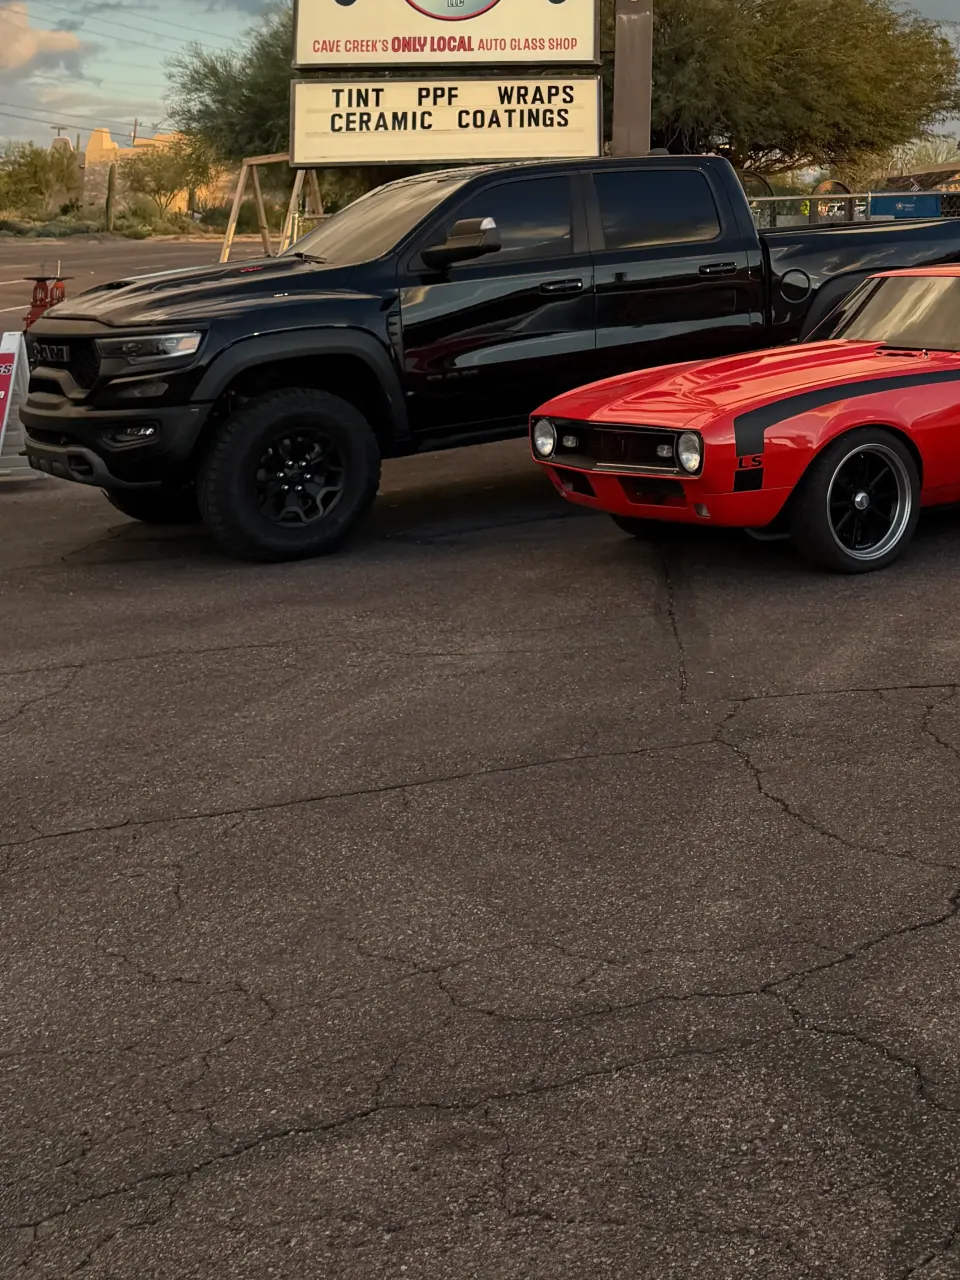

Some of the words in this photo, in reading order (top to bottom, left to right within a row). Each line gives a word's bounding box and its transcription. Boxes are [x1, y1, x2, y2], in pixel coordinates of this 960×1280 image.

[312, 40, 341, 53] CAVE
[344, 39, 389, 53] CREEK'S
[391, 37, 427, 52] ONLY
[430, 36, 474, 52] LOCAL
[478, 38, 506, 51] AUTO
[510, 38, 545, 51] GLASS
[548, 37, 578, 51] SHOP
[332, 88, 384, 108] TINT
[417, 87, 459, 106] PPF
[498, 85, 574, 105] WRAPS
[330, 111, 433, 132] CERAMIC
[457, 108, 569, 129] COATINGS
[738, 455, 762, 469] LS
